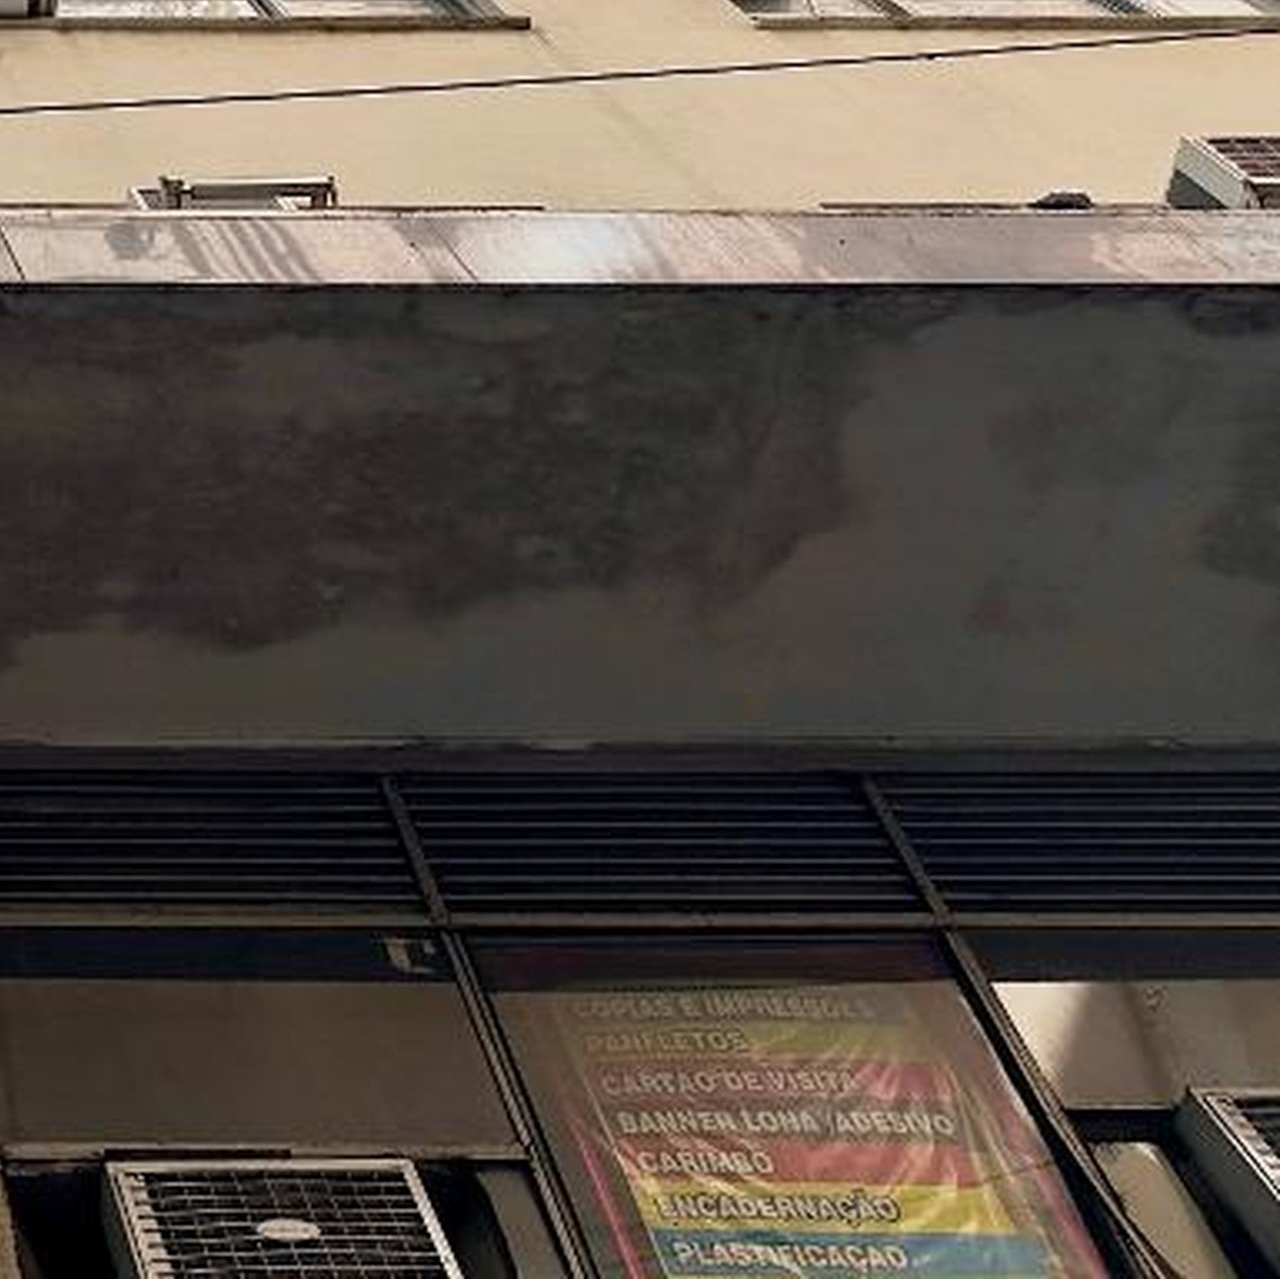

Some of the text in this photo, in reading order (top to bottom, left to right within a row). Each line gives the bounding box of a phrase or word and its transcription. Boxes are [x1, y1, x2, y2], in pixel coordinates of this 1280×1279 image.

[723, 1070, 761, 1094] DE
[768, 1067, 859, 1093] VISITA
[618, 1110, 731, 1135] BANNER
[637, 1151, 774, 1176] CARIMBO
